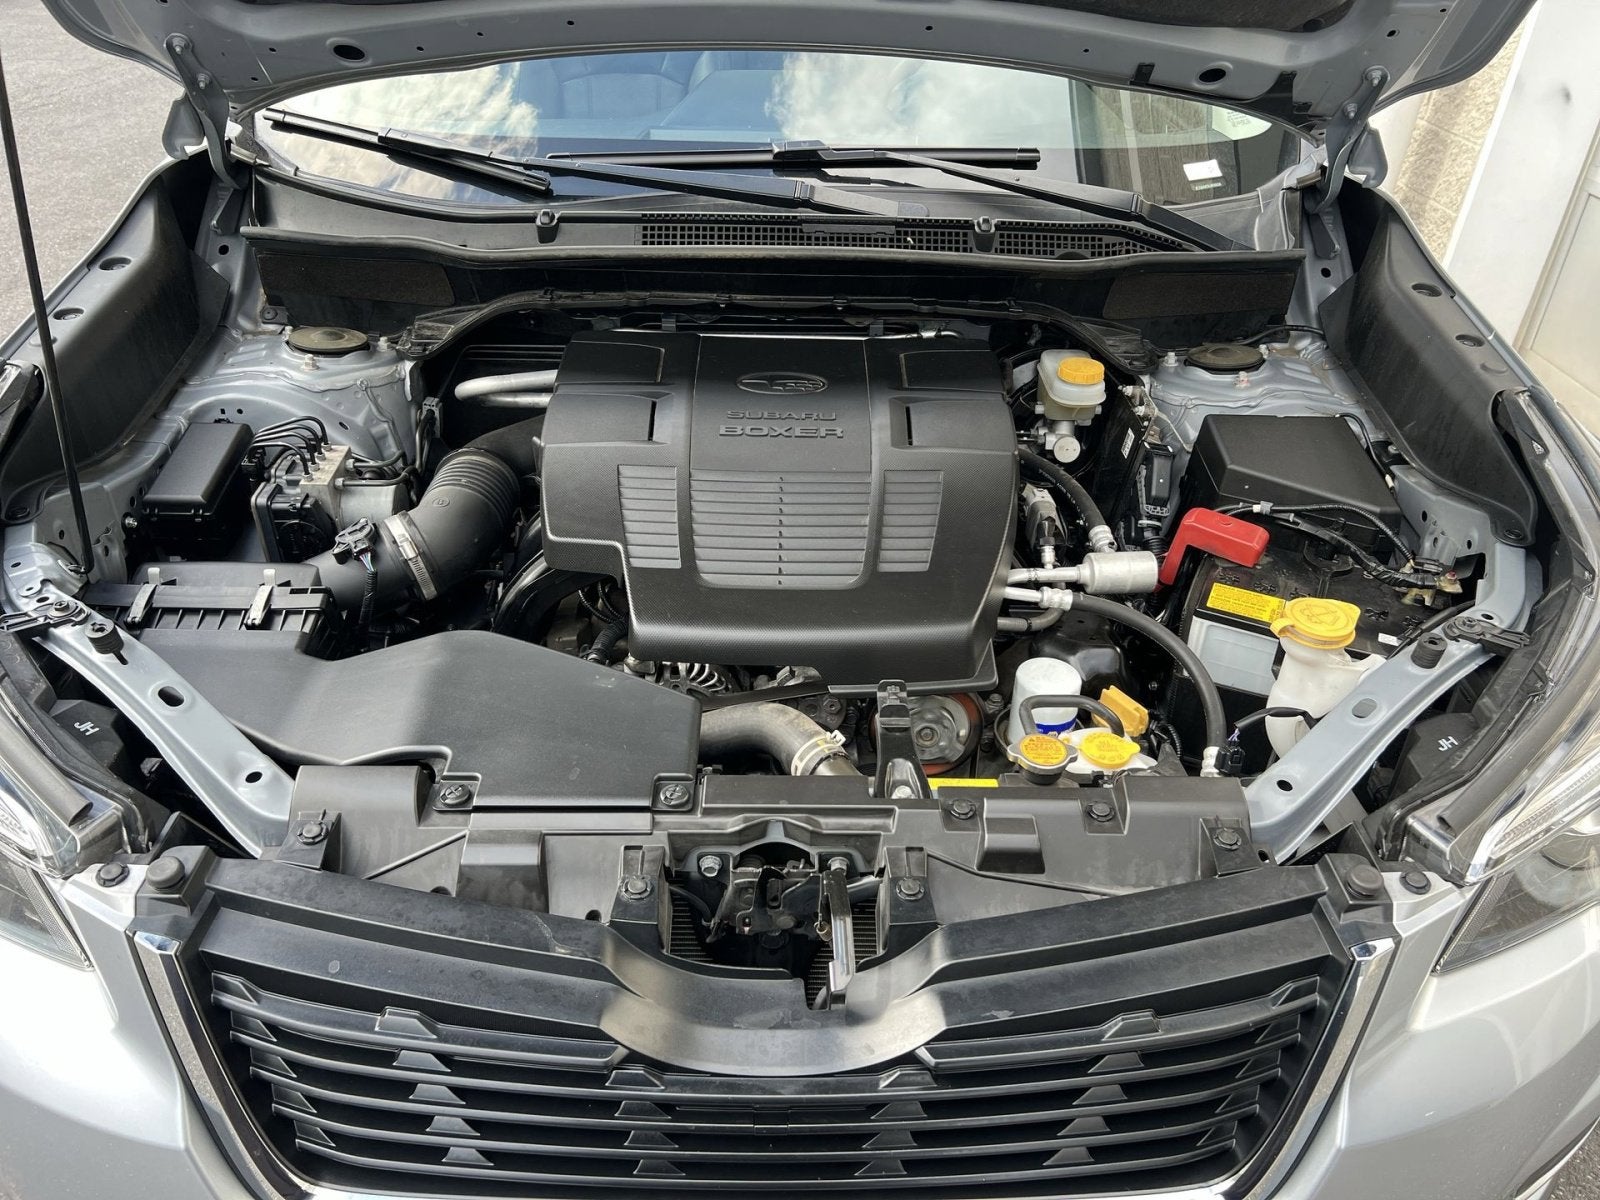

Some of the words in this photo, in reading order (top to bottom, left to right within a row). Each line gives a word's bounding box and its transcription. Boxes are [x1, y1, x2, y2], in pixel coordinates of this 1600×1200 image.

[727, 409, 837, 421] SUBARU
[719, 425, 844, 439] BOXER
[74, 722, 99, 735] JH
[1438, 736, 1458, 751] JH
